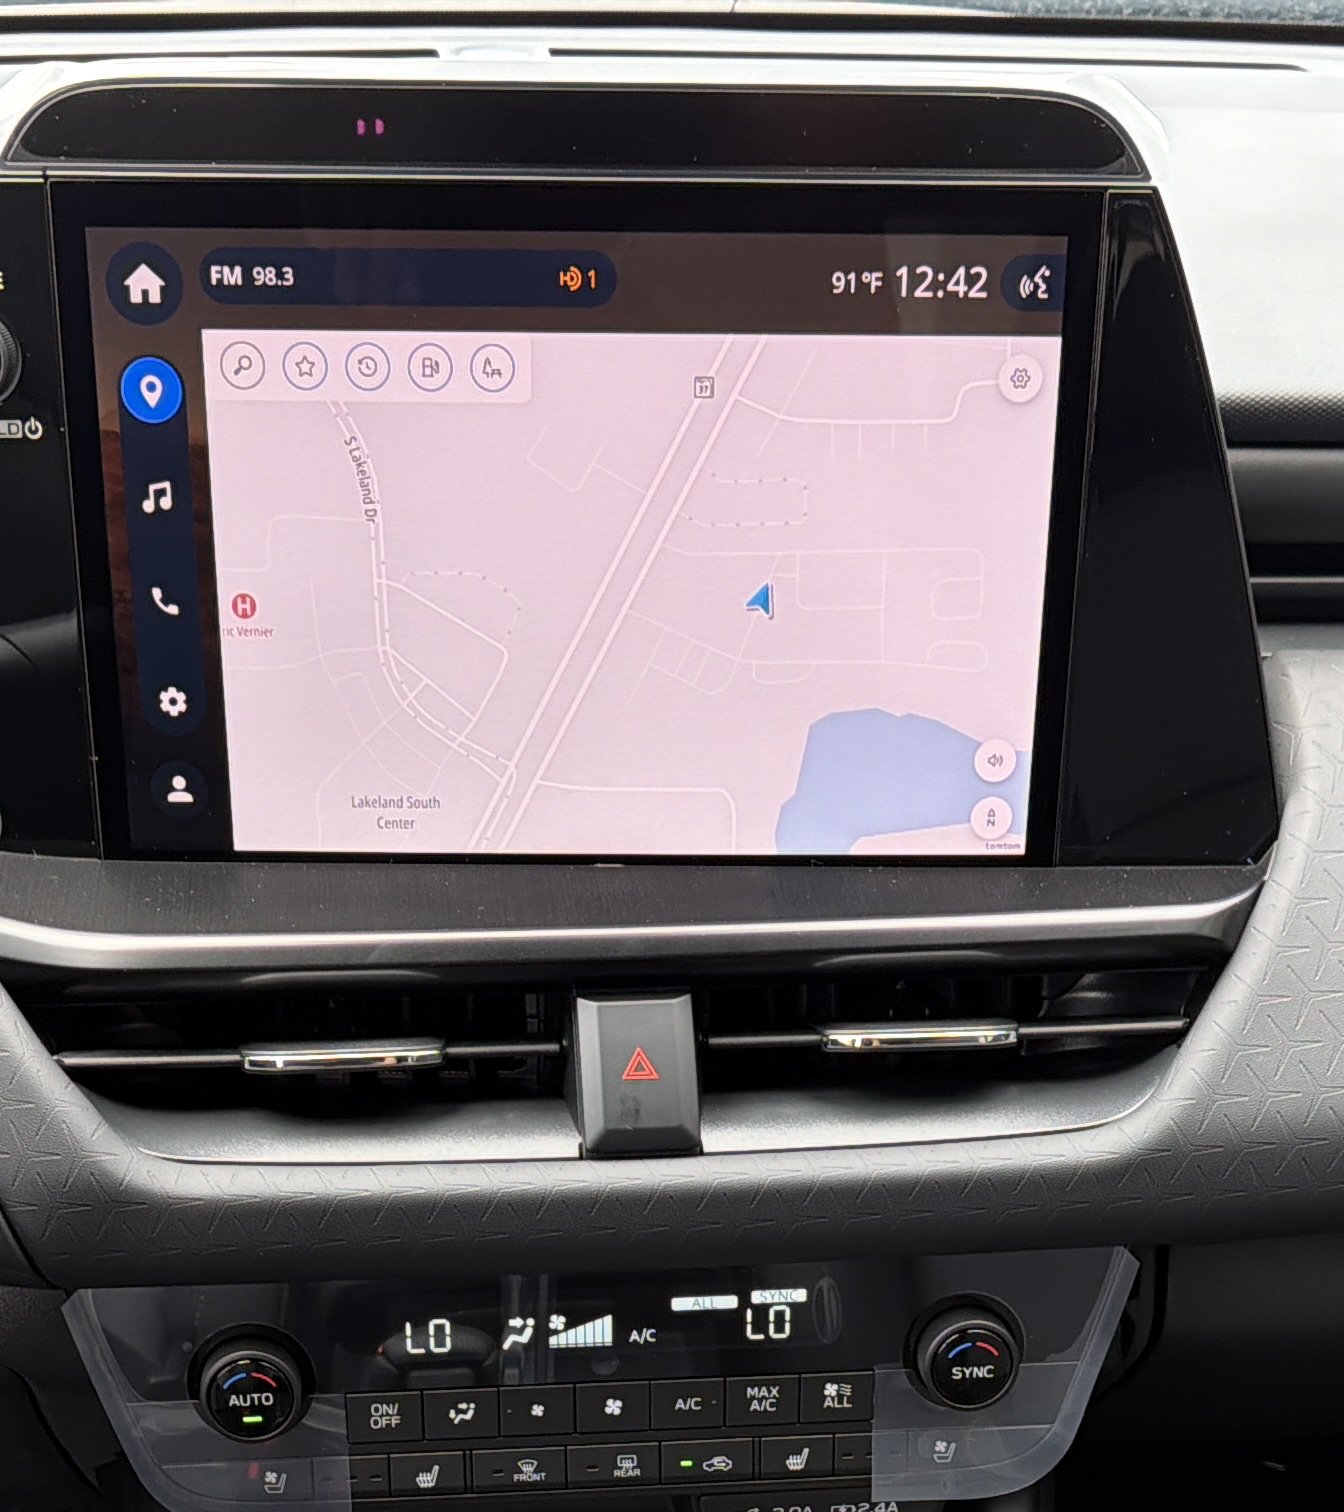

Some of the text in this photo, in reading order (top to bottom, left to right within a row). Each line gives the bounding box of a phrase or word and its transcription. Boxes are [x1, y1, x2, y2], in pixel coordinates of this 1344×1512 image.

[210, 265, 295, 286] FM 98.3
[896, 265, 988, 299] 12:42
[344, 435, 377, 524] S Lakeland Dr
[236, 626, 273, 637] Vernier
[351, 795, 441, 809] Lakeland South
[376, 816, 415, 829] Center
[985, 842, 1021, 850] tomtom
[691, 1289, 799, 1309] ALL SYNC
[746, 1305, 791, 1340] LO
[405, 1318, 452, 1354] LO
[628, 1328, 657, 1344] A/C
[951, 1365, 995, 1380] SYNC
[746, 1385, 780, 1399] MAX
[228, 1392, 274, 1407] AUTO
[674, 1397, 702, 1411] A/C
[749, 1399, 777, 1413] A/C
[823, 1397, 853, 1409] ALL
[370, 1402, 399, 1416] ON/
[369, 1416, 402, 1430] OFF
[513, 1472, 546, 1482] FRONT
[613, 1468, 641, 1478] REAR
